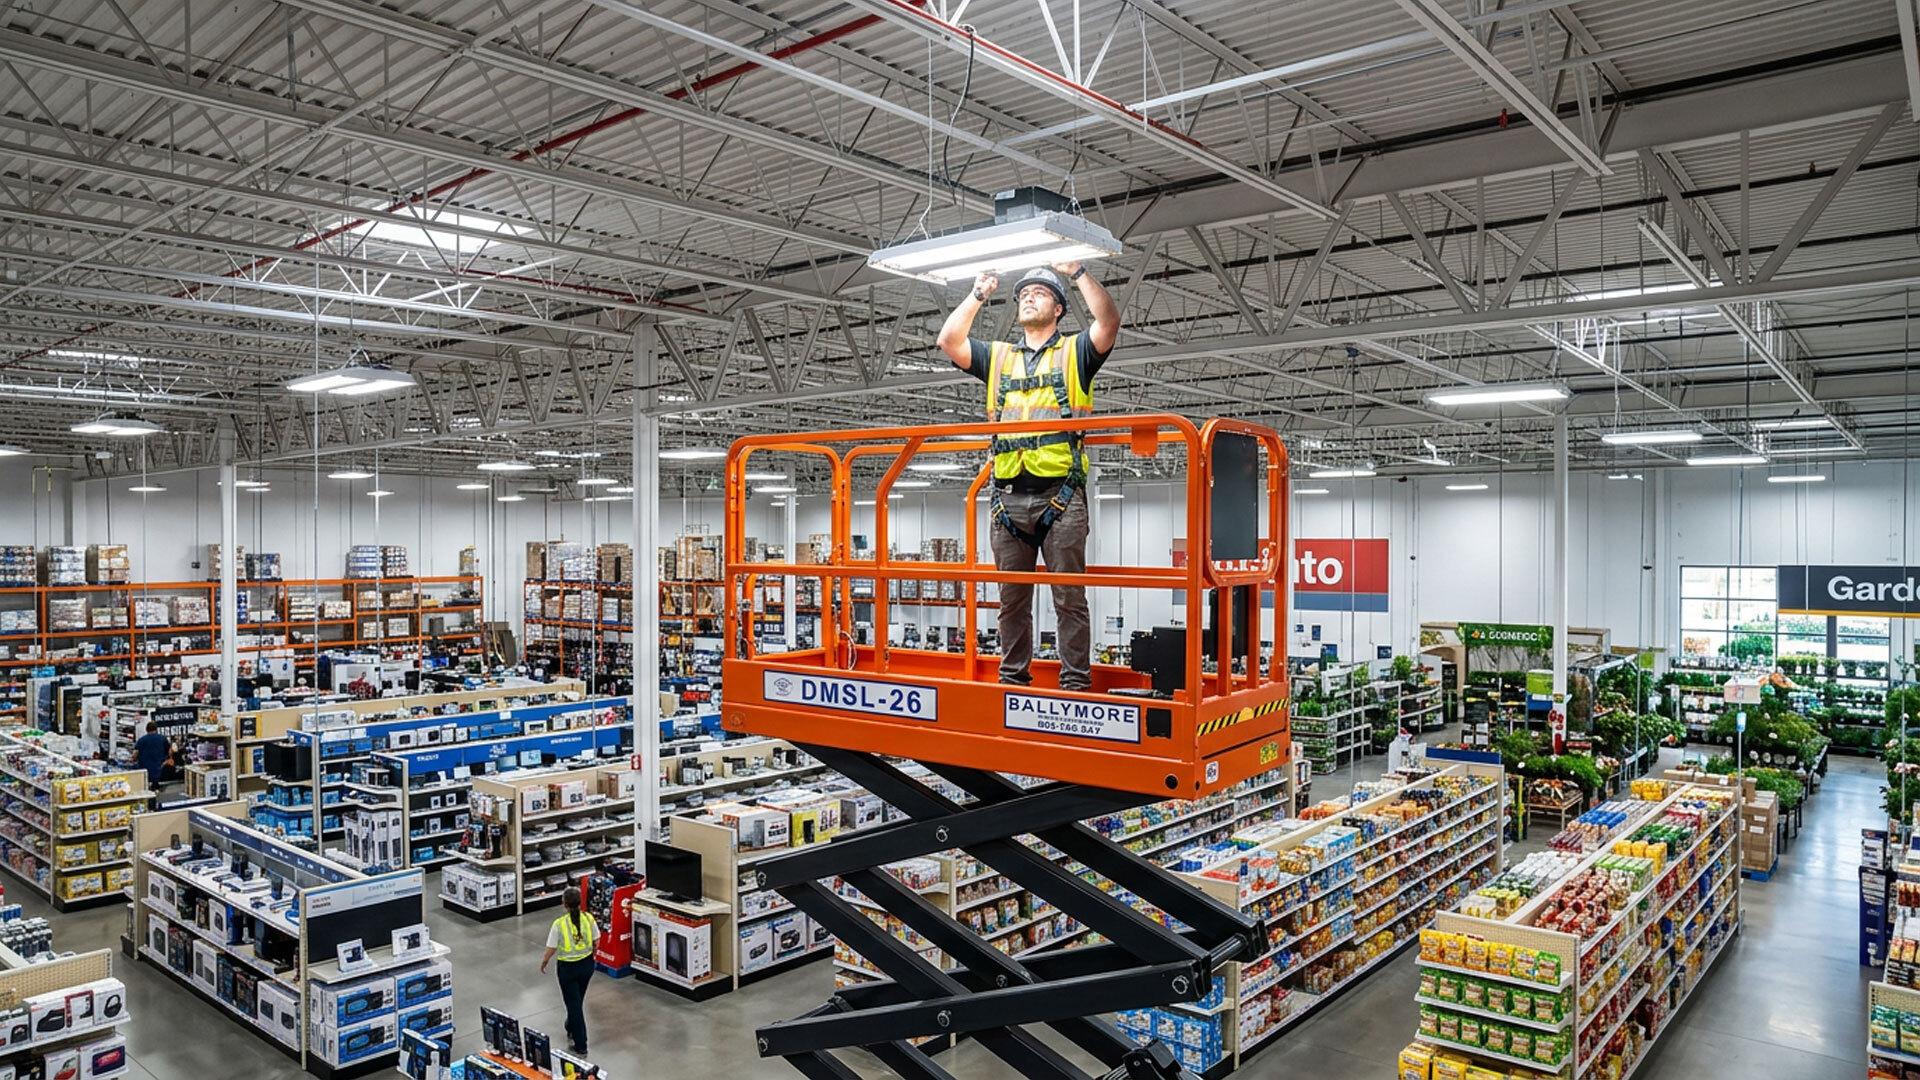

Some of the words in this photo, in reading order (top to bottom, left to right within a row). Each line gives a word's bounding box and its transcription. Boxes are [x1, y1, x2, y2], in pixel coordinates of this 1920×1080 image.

[1827, 575, 1920, 602] Gard
[801, 679, 922, 714] DMSL-26
[1008, 697, 1135, 724] BALLYMORE
